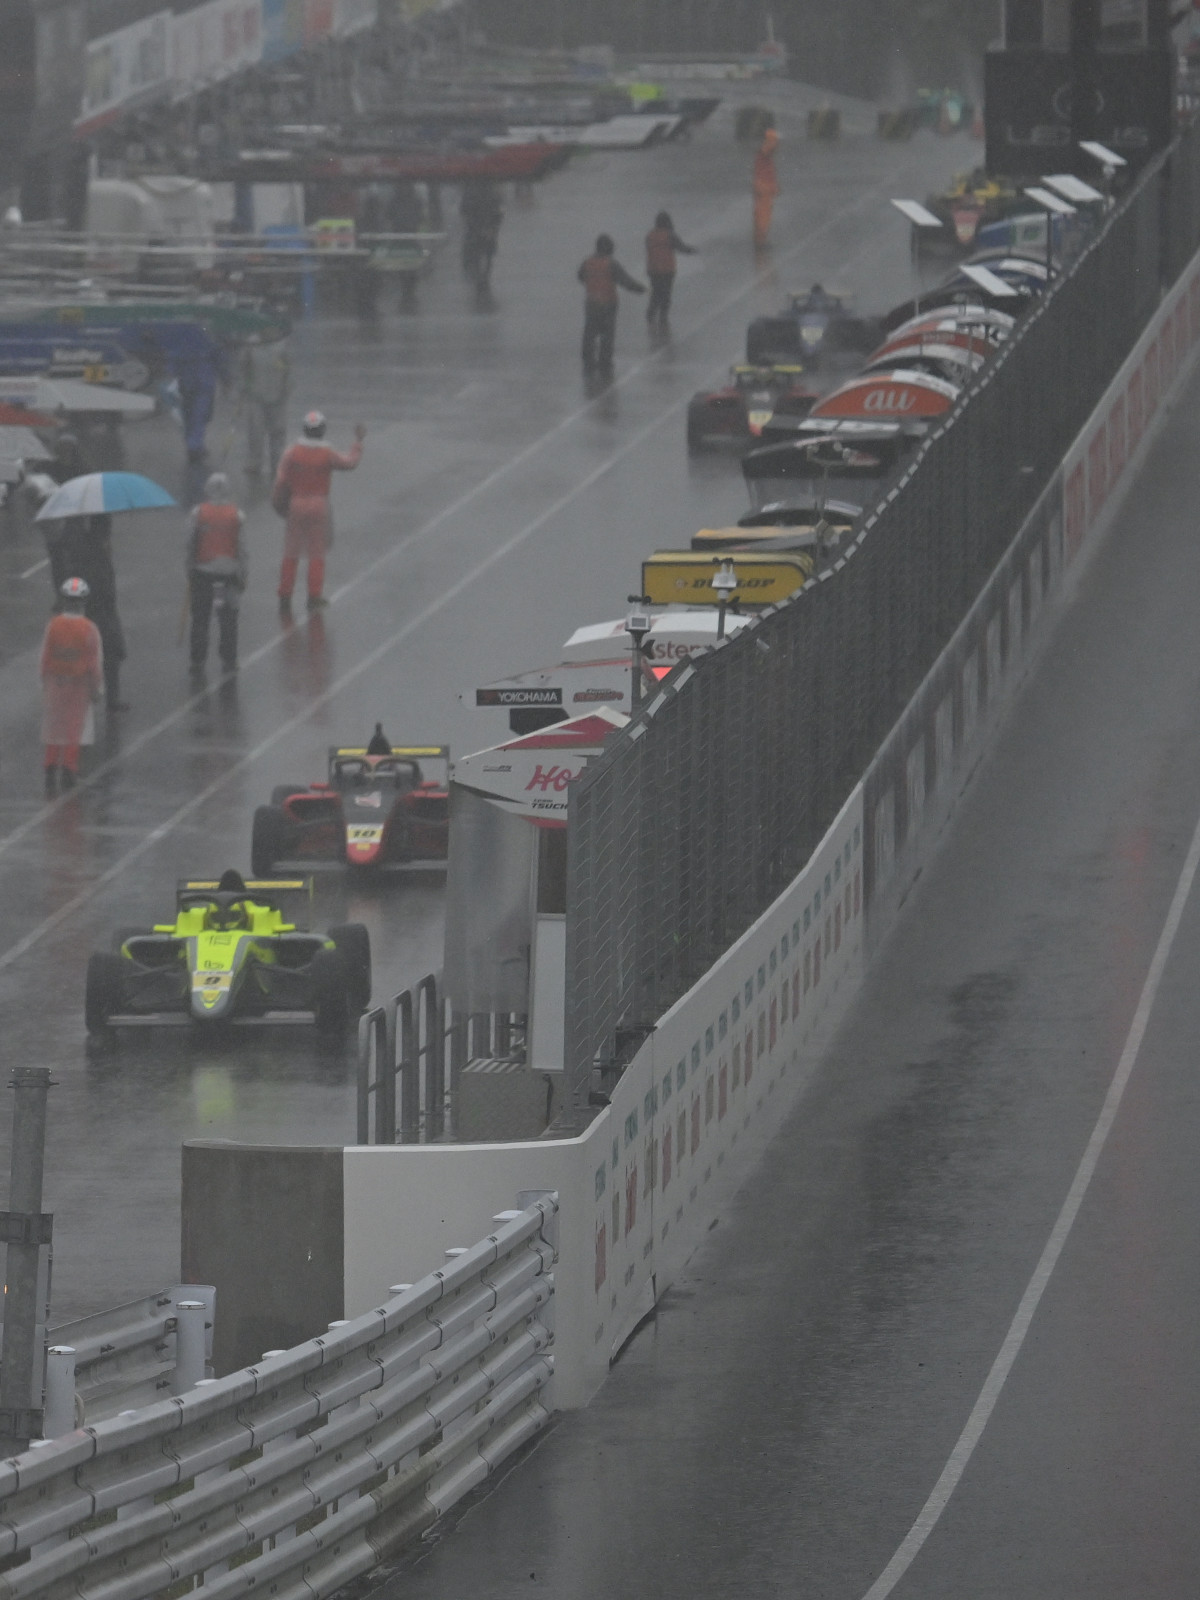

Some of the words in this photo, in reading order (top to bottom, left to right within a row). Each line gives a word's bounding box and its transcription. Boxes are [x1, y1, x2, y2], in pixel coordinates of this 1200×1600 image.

[863, 388, 916, 411] au
[693, 578, 776, 587] DLOP
[498, 691, 558, 702] YOKOHAMA
